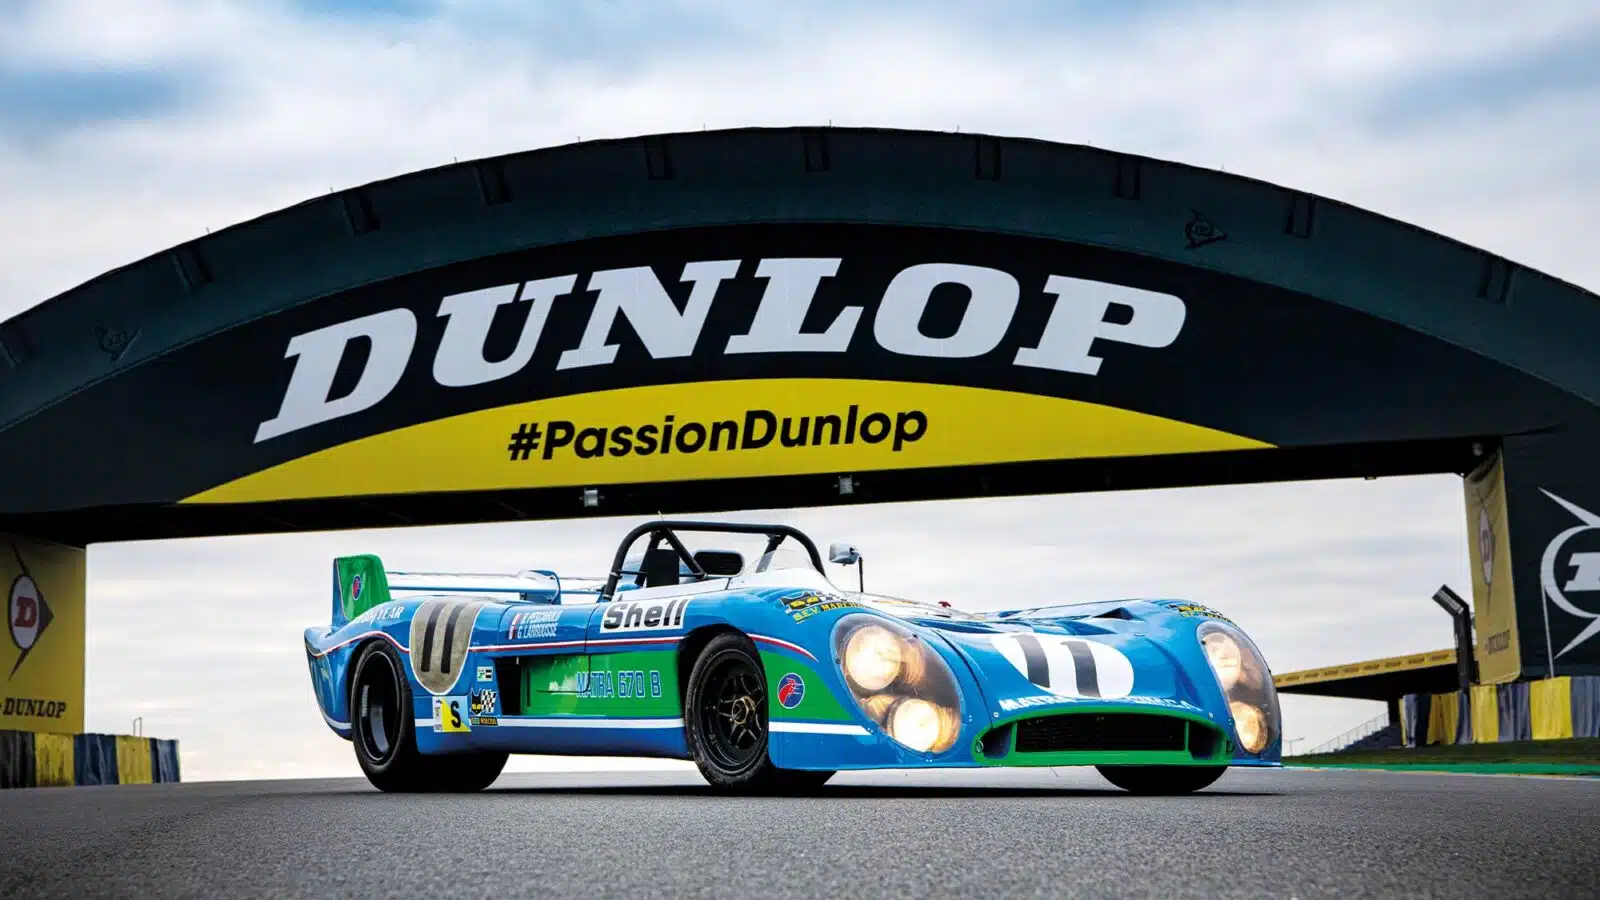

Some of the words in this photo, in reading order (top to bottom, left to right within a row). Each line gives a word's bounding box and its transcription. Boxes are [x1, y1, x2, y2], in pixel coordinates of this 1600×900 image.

[253, 257, 1187, 444] DUNLOP
[507, 404, 928, 461] #PassionDunlop
[14, 596, 37, 628] D
[603, 599, 689, 629] Shell
[420, 602, 468, 674] 11
[1010, 634, 1102, 698] 11
[576, 670, 615, 698] MATRA
[618, 670, 646, 698] 670
[649, 670, 662, 698] B
[3, 696, 67, 719] DUNLOP
[450, 700, 462, 729] S
